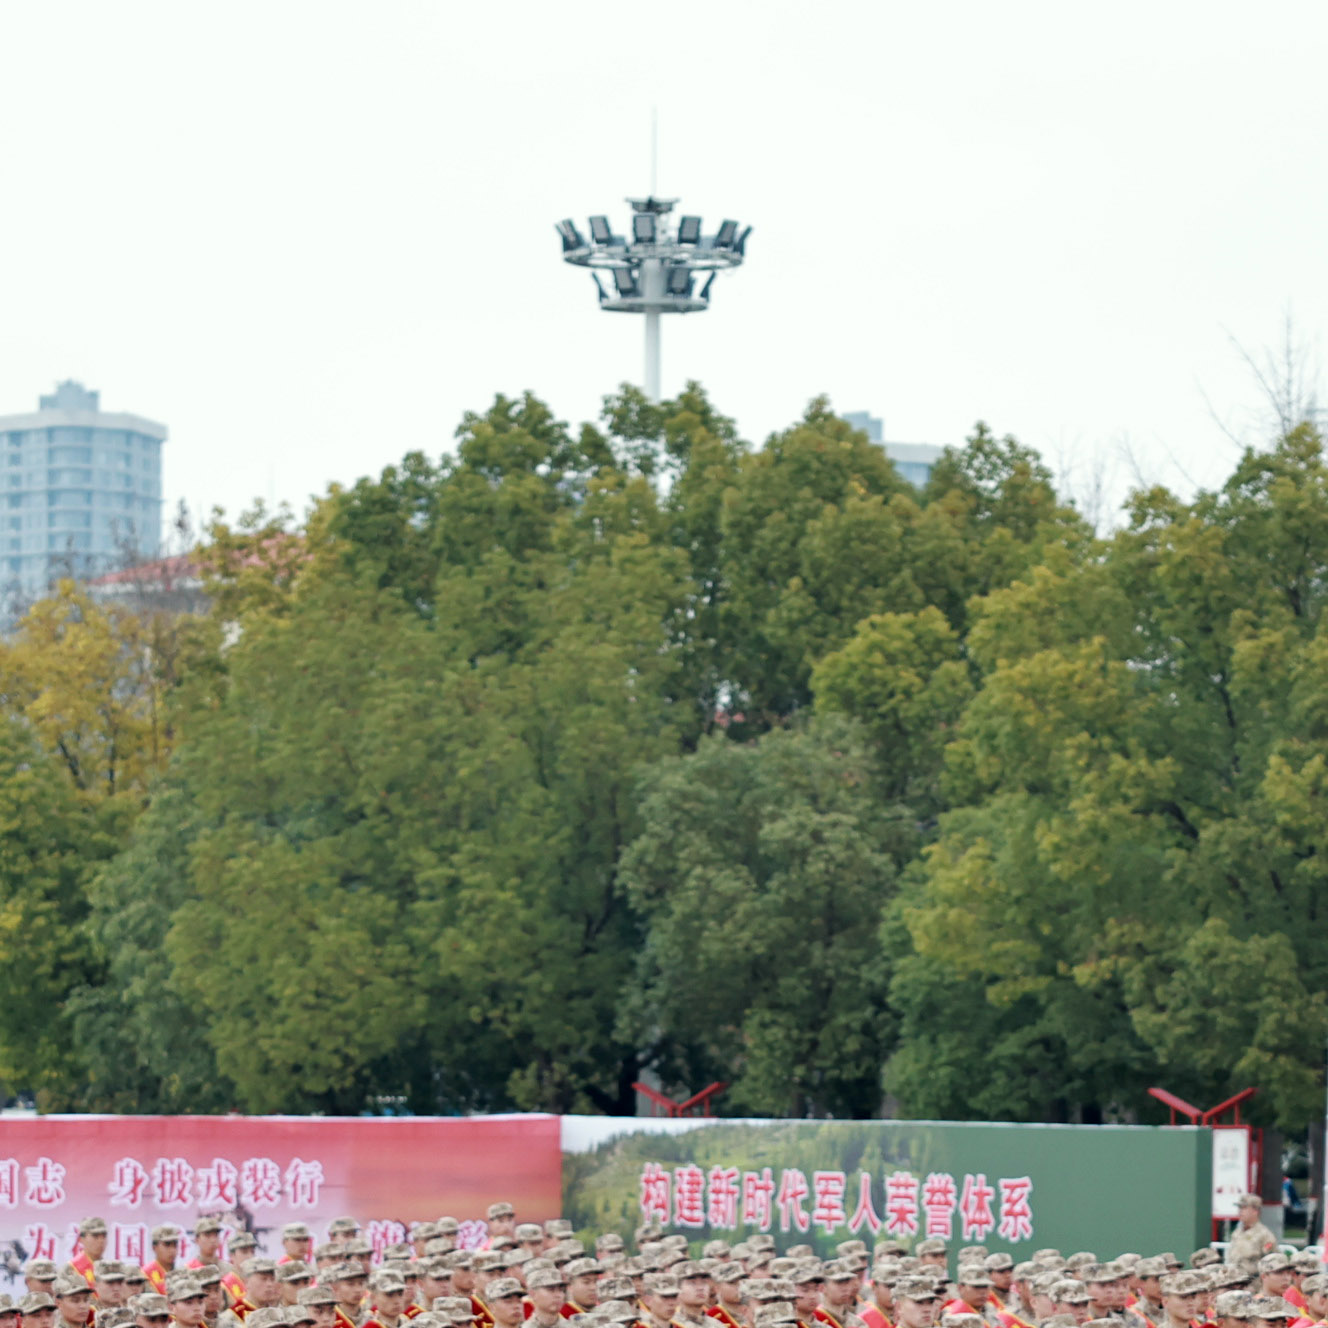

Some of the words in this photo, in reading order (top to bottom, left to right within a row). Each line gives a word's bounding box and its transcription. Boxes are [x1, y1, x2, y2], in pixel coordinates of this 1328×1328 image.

[108, 1156, 325, 1208] 身披戎装行
[639, 1161, 1034, 1242] 构建新时代军人荣誉体系
